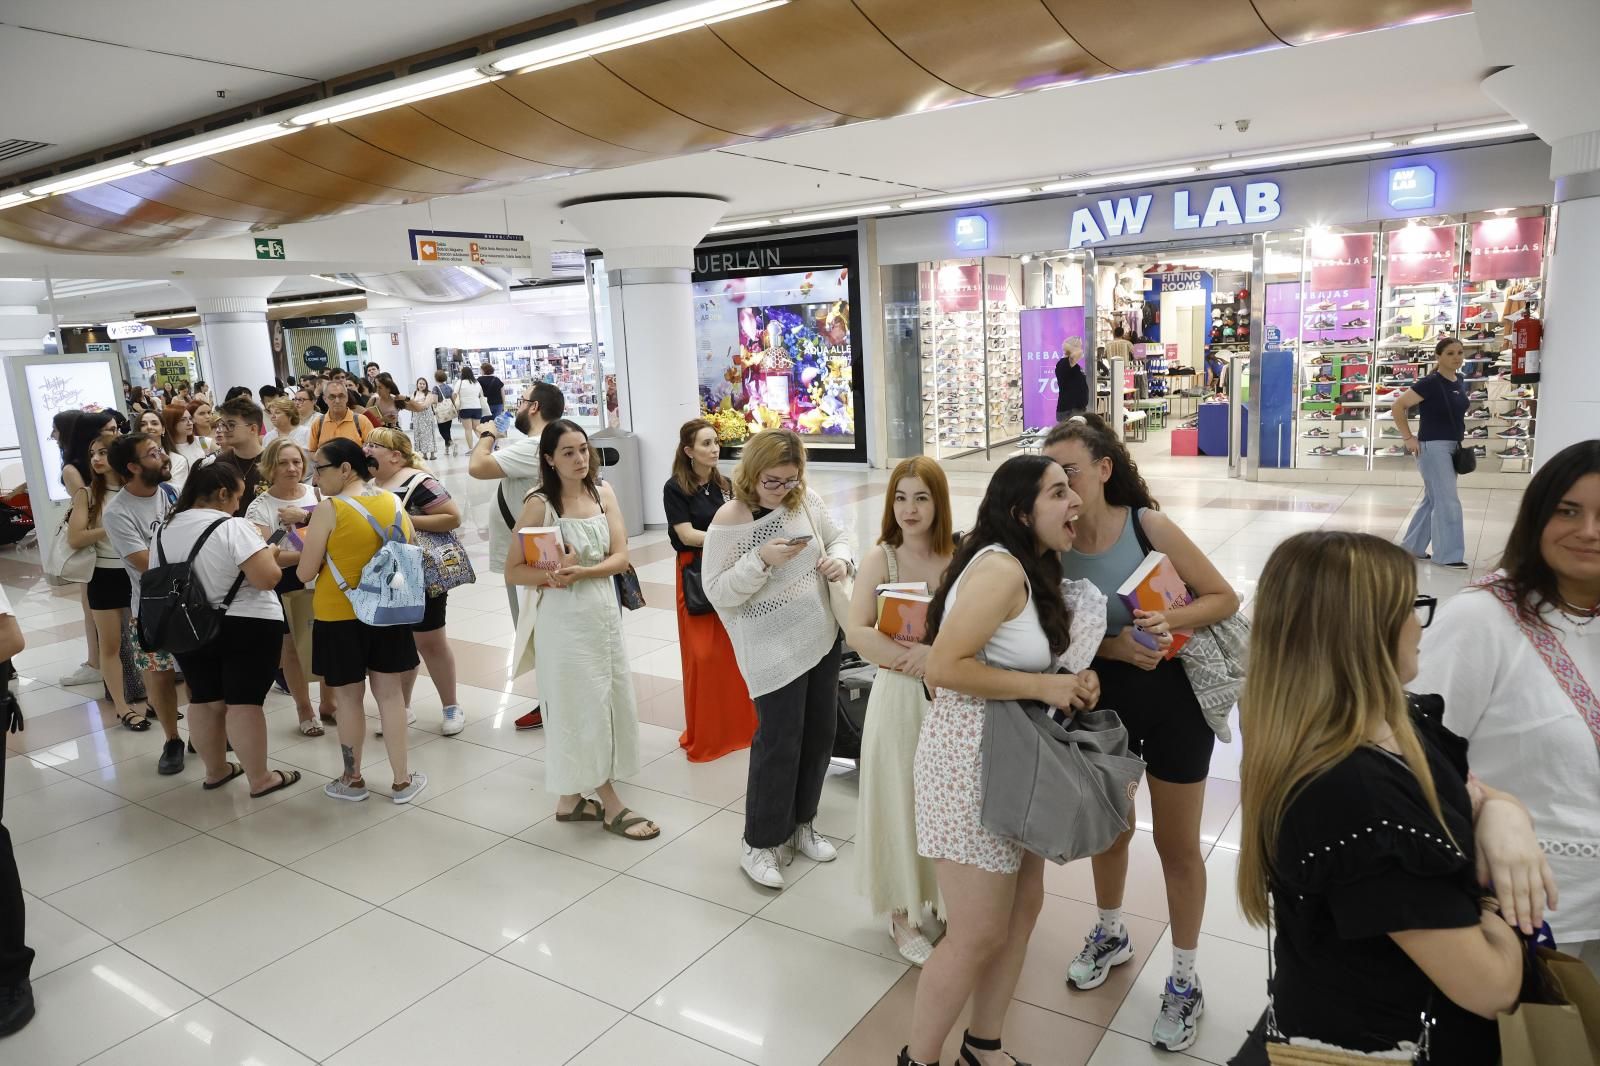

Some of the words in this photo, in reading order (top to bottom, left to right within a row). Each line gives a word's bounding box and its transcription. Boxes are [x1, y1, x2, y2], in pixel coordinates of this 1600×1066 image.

[1393, 170, 1415, 180] AW
[1392, 179, 1416, 190] LAB
[1069, 195, 1153, 249] AW
[1174, 182, 1281, 230] LAB
[1474, 243, 1539, 256] REBAJAS
[695, 247, 780, 273] UERLAIN
[1391, 250, 1451, 262] REAJAS
[1162, 271, 1201, 282] FITTING
[1161, 281, 1201, 291] ROOMS
[804, 346, 829, 355] AQUA
[1027, 350, 1065, 360] REBA
[1038, 377, 1060, 394] 70
